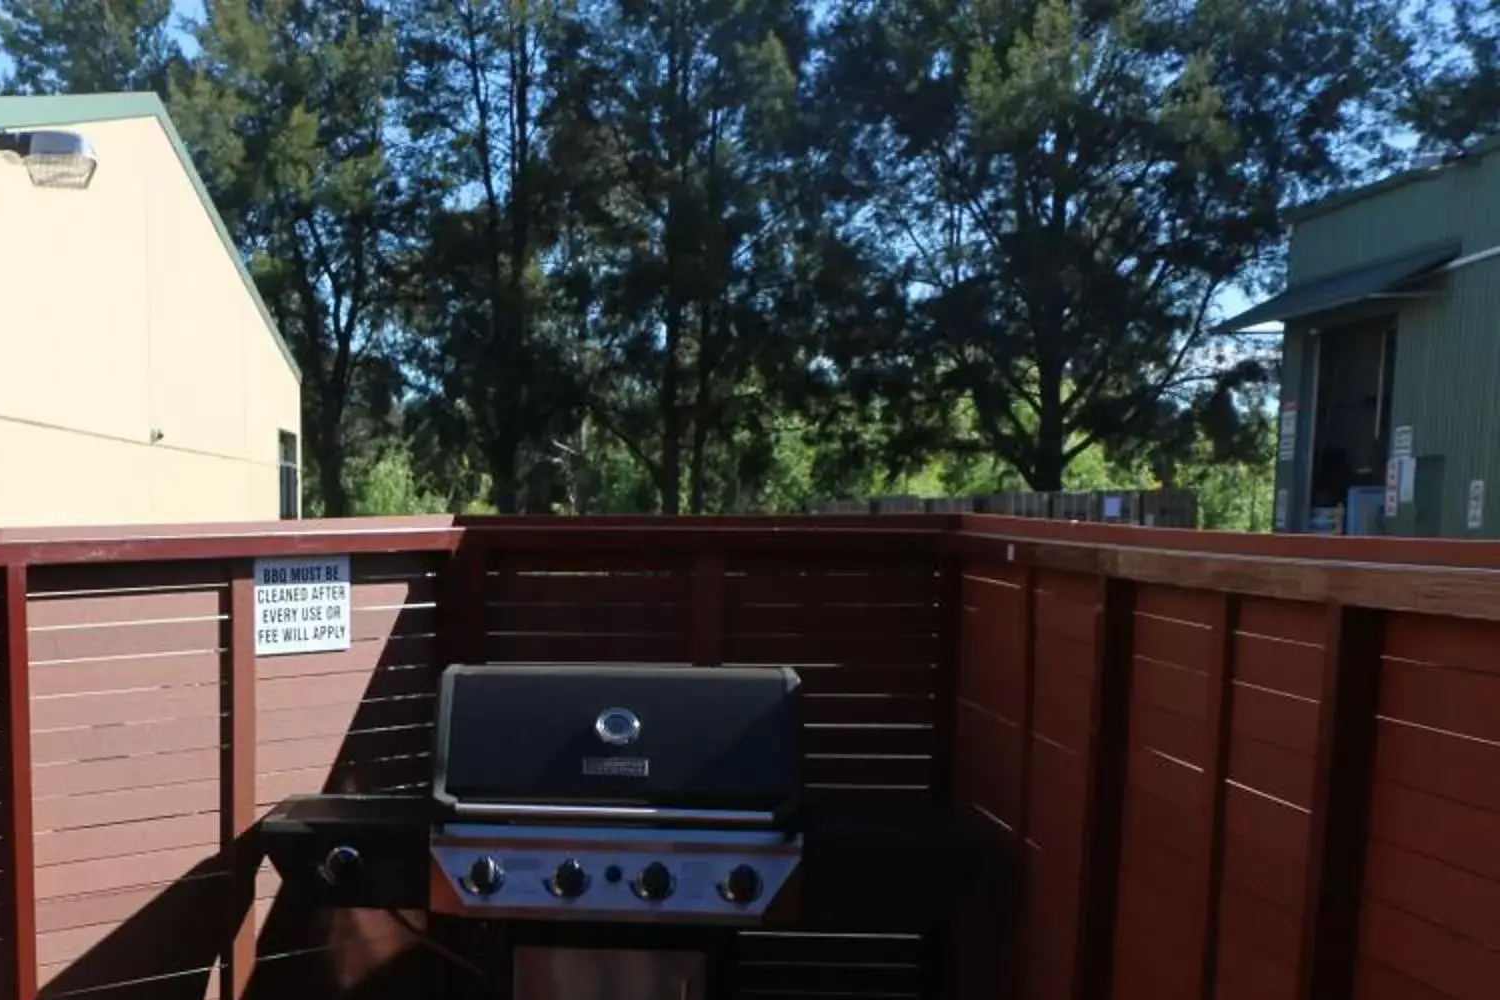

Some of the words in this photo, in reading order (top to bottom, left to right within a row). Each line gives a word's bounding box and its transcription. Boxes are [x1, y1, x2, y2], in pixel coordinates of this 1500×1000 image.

[263, 568, 287, 584] BBQ
[291, 566, 322, 583] MUST
[325, 566, 339, 581] BE
[258, 587, 308, 604] CLEANED
[311, 585, 346, 601] AFTER
[263, 607, 298, 624] EVERY
[301, 606, 323, 621] USE
[325, 605, 341, 620] OR
[258, 629, 279, 644] FEE
[282, 627, 309, 642] WILL
[313, 626, 345, 640] APPLY
